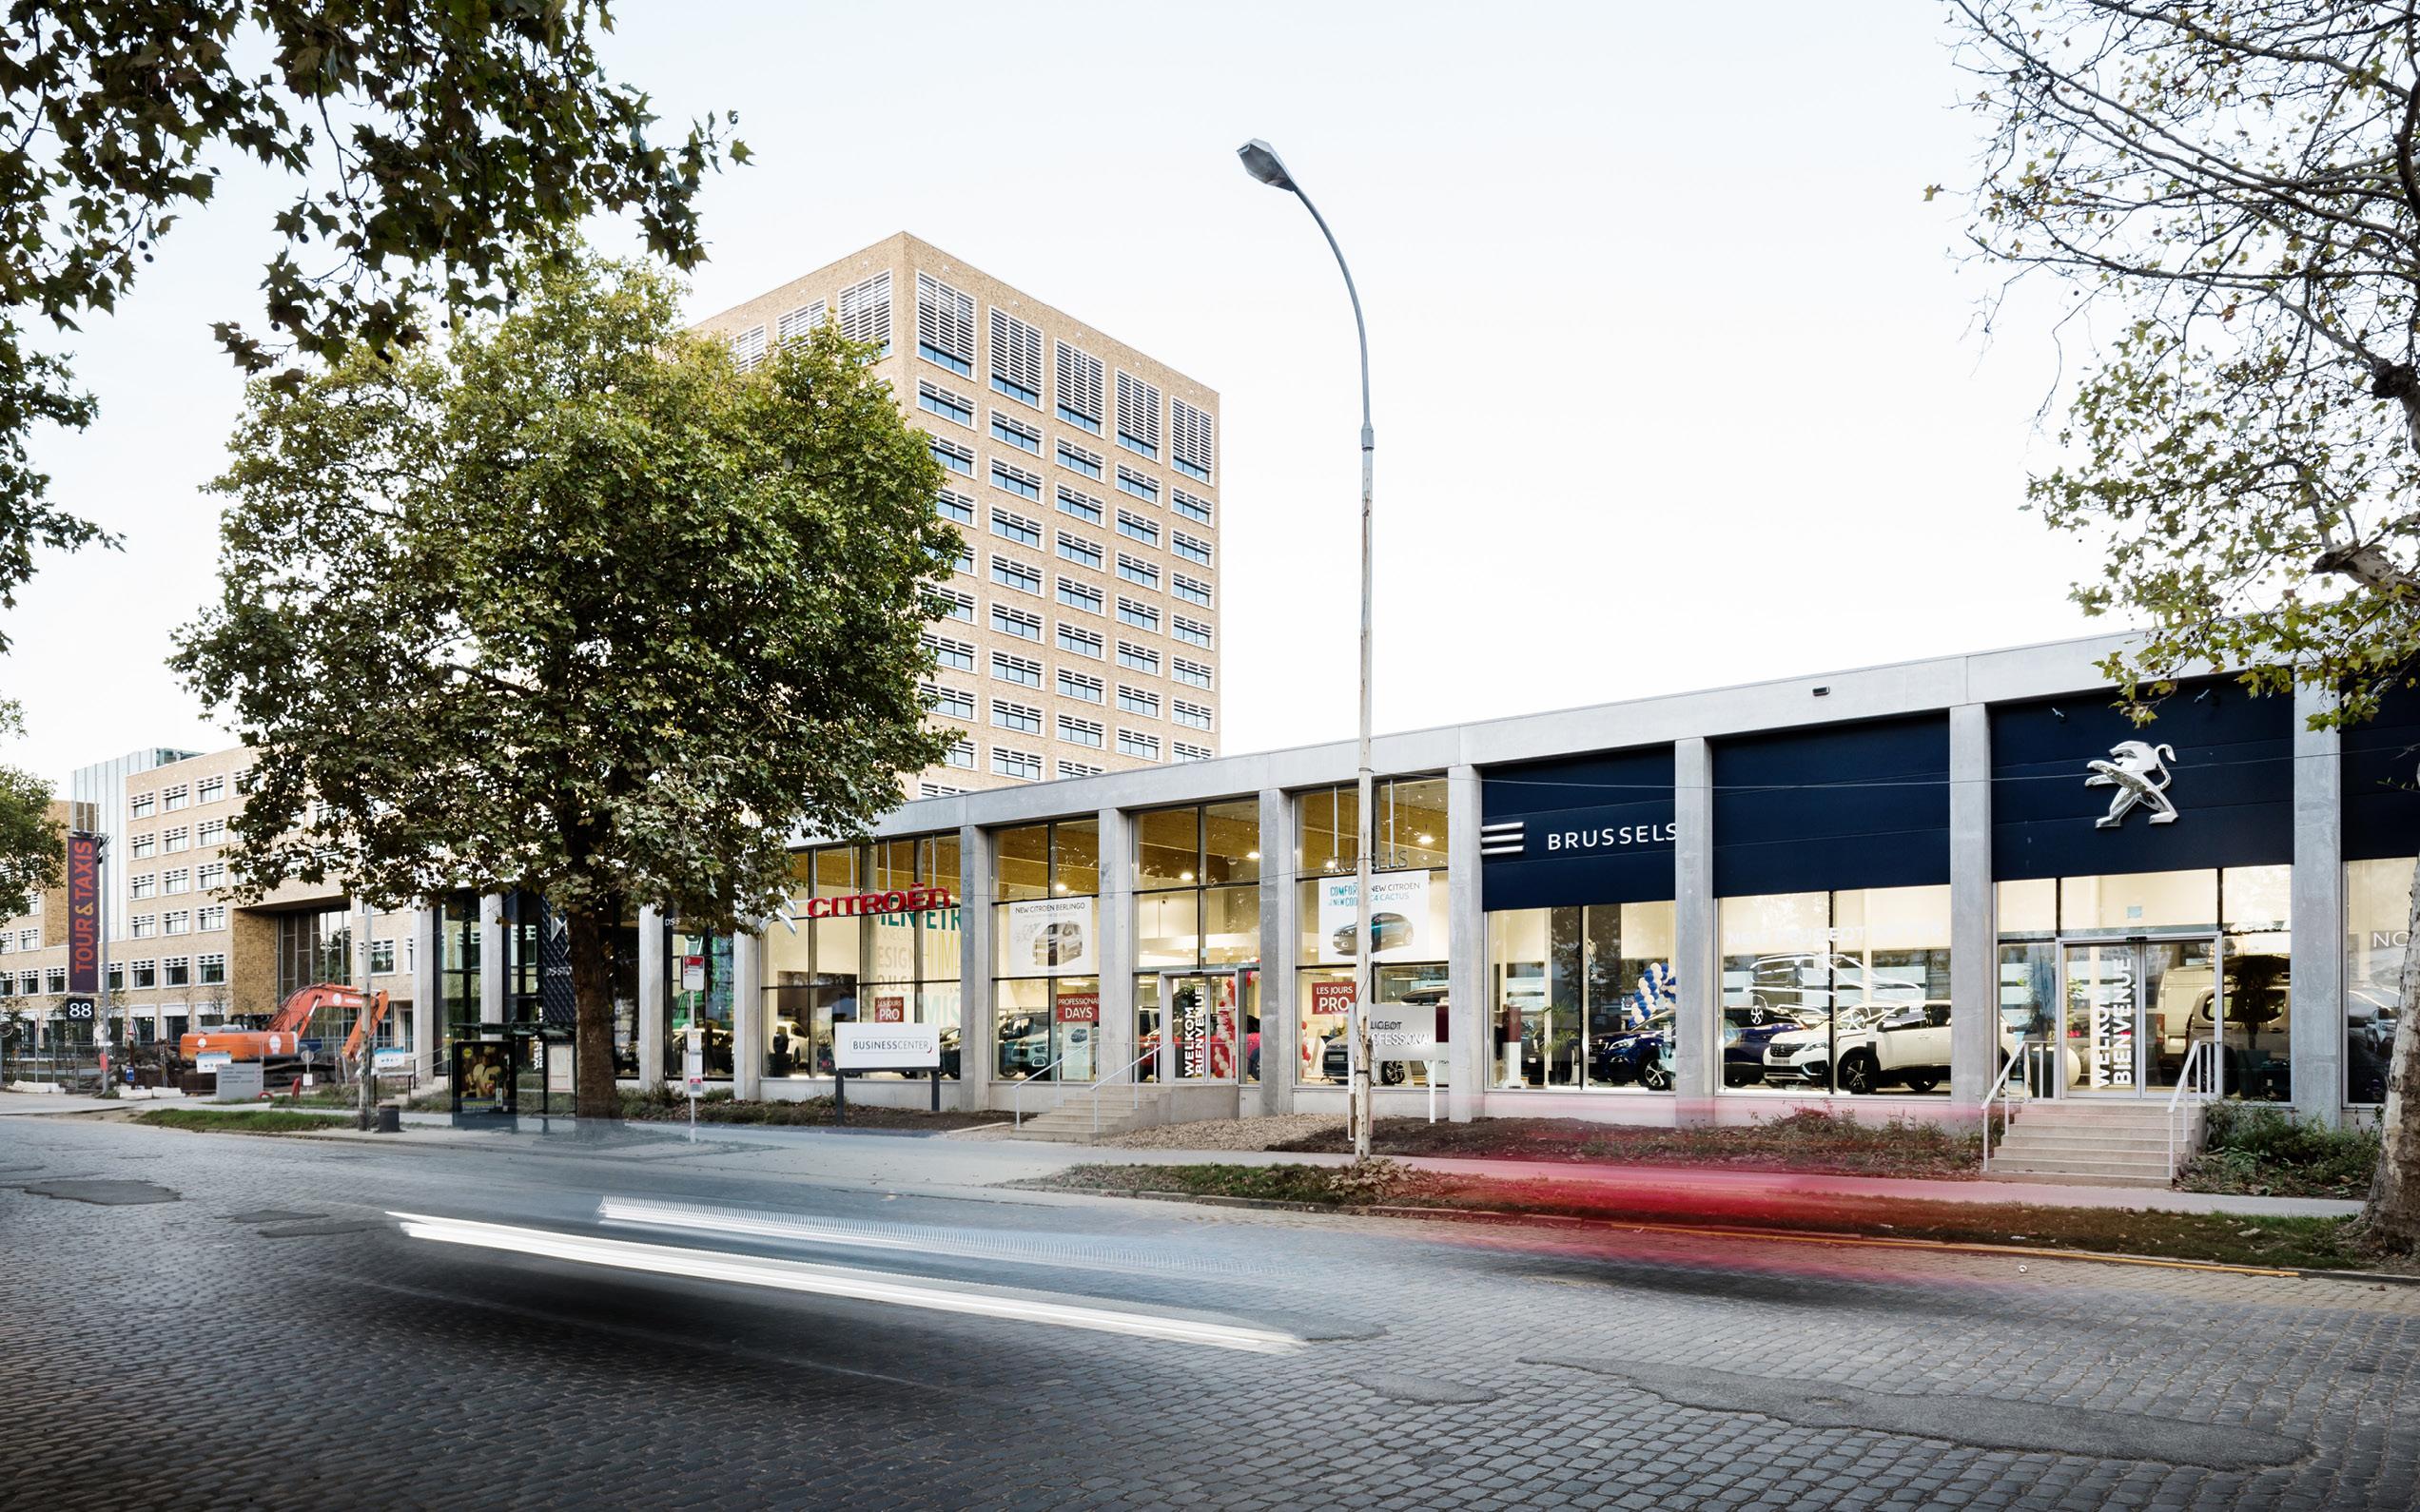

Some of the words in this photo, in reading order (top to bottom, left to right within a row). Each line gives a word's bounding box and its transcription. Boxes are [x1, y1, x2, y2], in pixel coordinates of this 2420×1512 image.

[1548, 823, 1675, 851] BRUSSELS
[75, 842, 93, 900] TAXIS
[1330, 885, 1357, 897] COMFOR
[1371, 884, 1387, 893] NEW
[1379, 892, 1409, 902] CACTUS
[75, 901, 93, 916] &
[1056, 901, 1085, 912] BERLINGO
[75, 920, 93, 974] TOUR
[1330, 986, 1354, 996] JOURS
[68, 1002, 92, 1018] 88
[1318, 997, 1350, 1012] PRO
[879, 1009, 900, 1020] PRO
[1065, 1007, 1093, 1018] DAYS
[2114, 958, 2132, 1085] BIENVENUE
[852, 1040, 928, 1051] BUSINESSCENTER
[1184, 1007, 1195, 1077] WELKOM
[2093, 989, 2110, 1089] WELKOM
